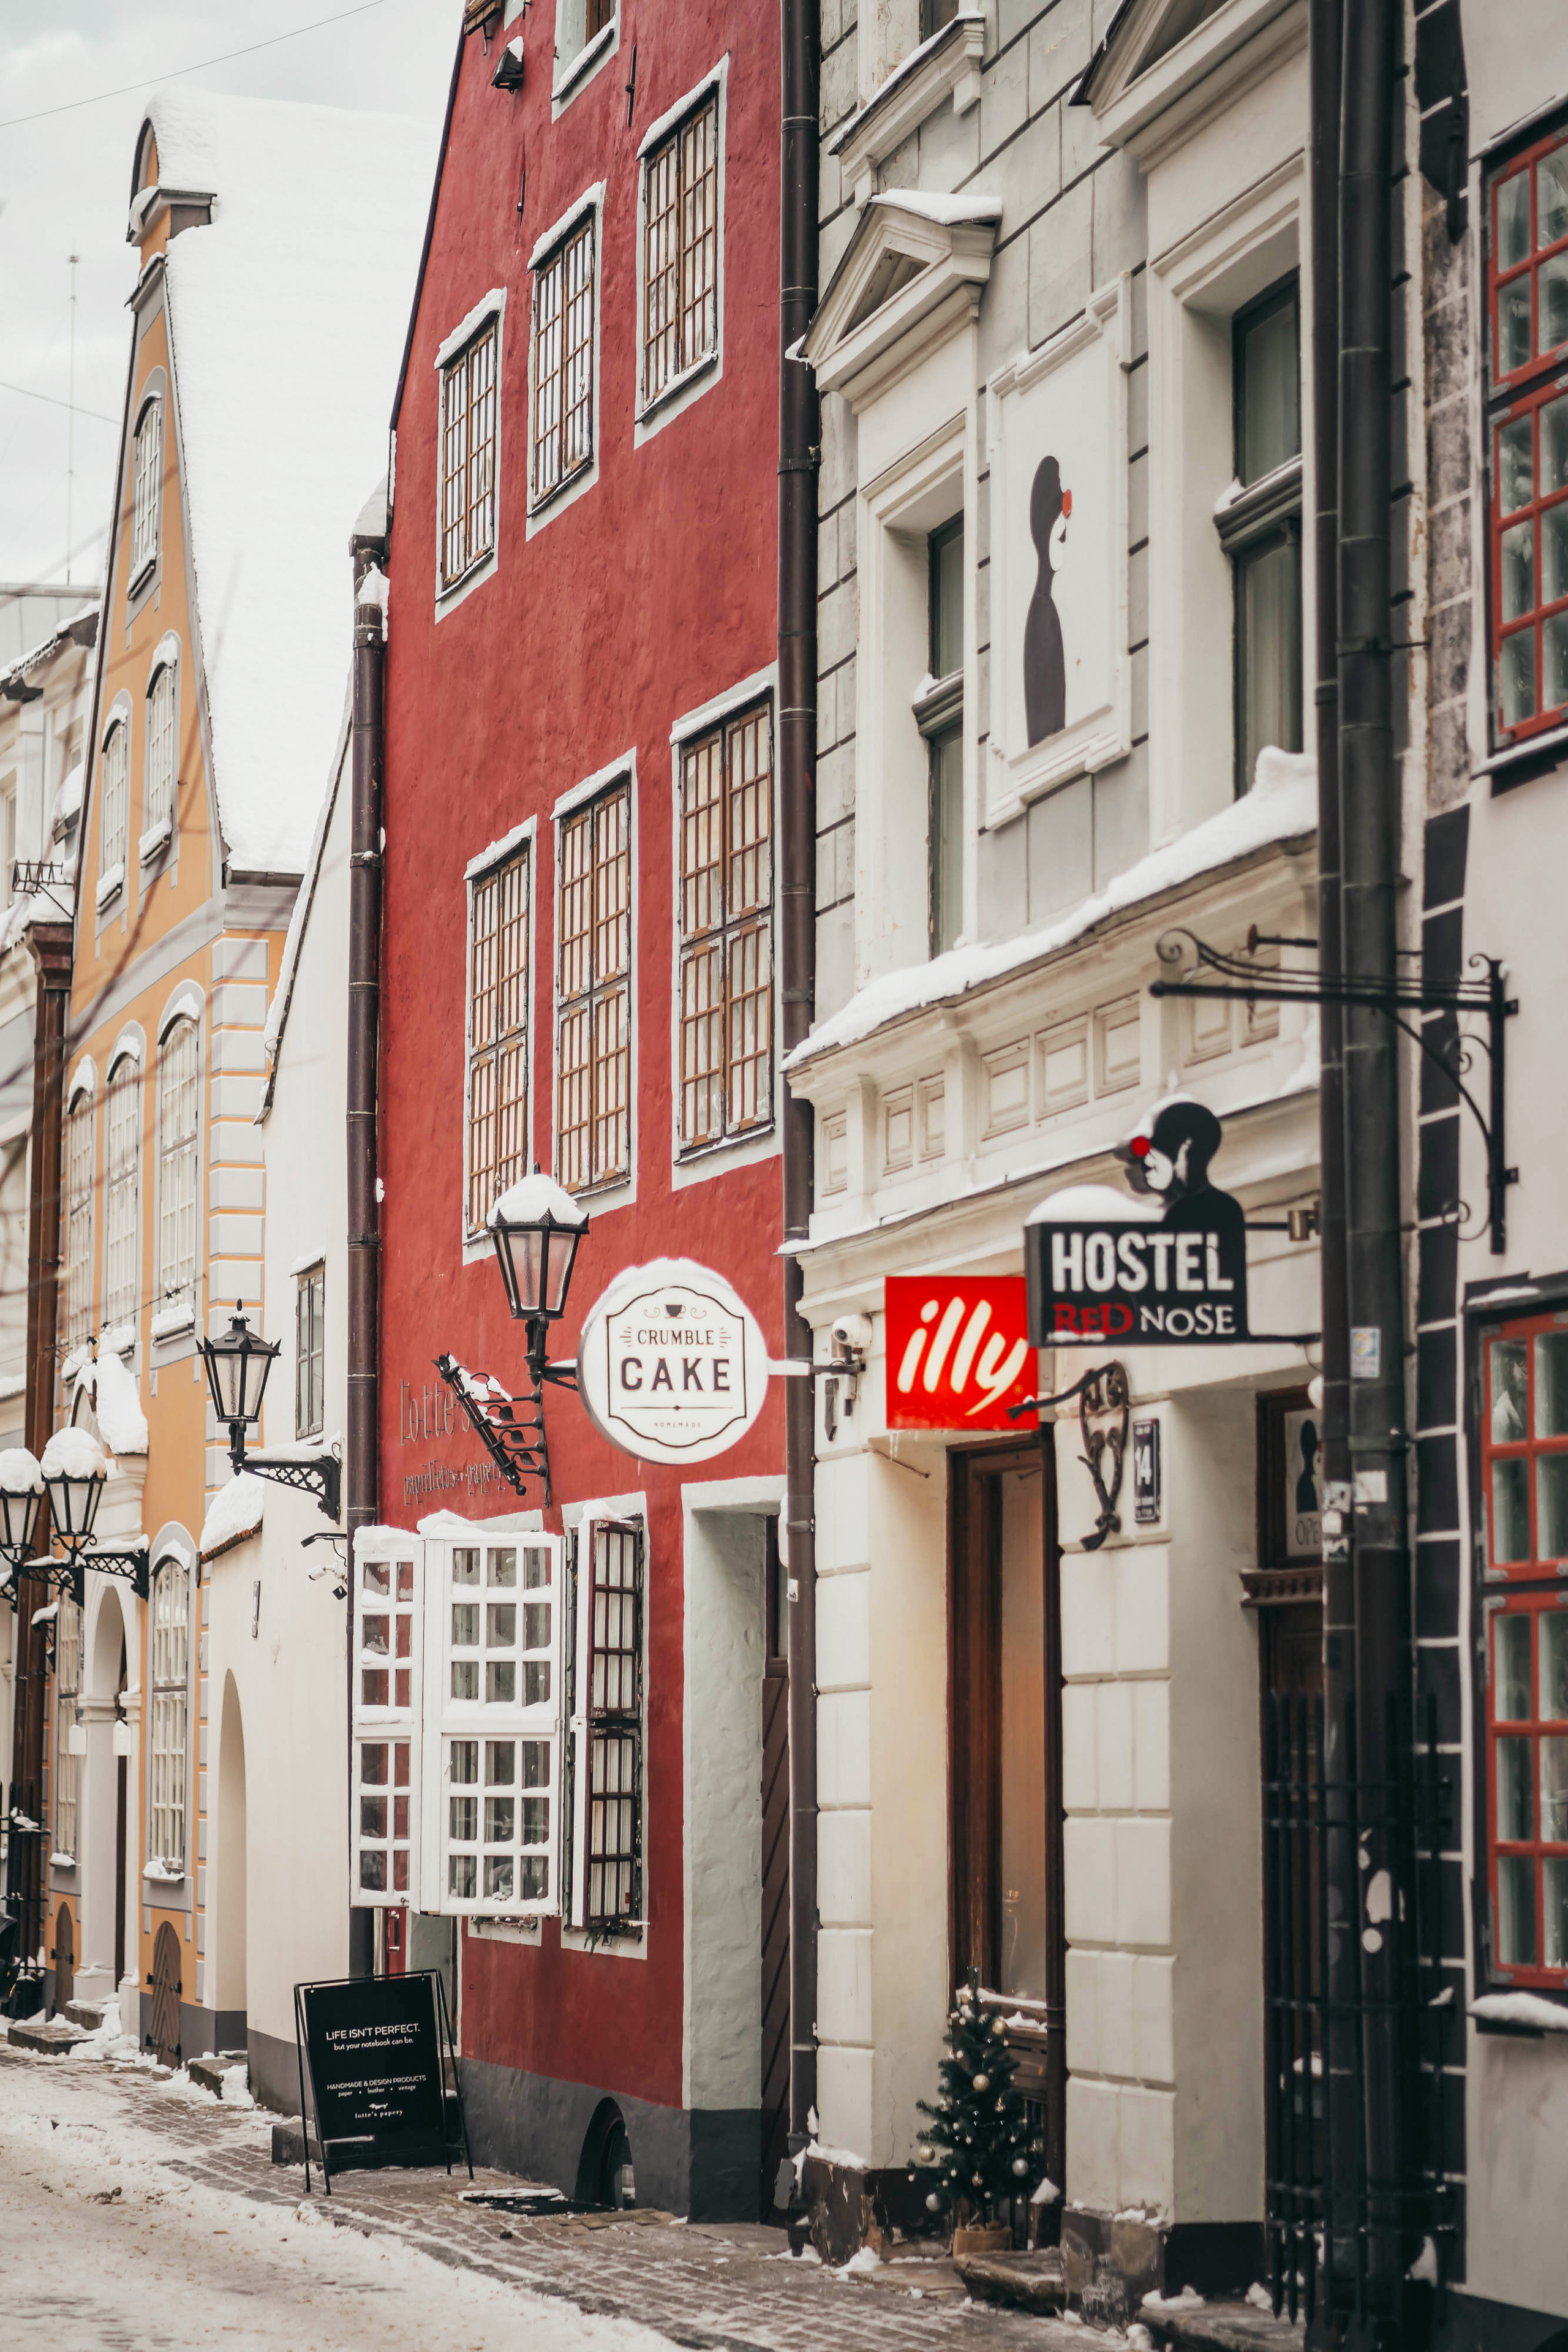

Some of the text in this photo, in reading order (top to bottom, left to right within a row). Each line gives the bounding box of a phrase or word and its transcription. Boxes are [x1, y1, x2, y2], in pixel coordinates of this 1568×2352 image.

[1051, 1232, 1234, 1292] HOSTEL
[1053, 1303, 1237, 1336] RED NOSE
[638, 1329, 715, 1346] CRUMBLE
[897, 1296, 1028, 1415] illy
[620, 1357, 731, 1392] CAKE
[1135, 1444, 1152, 1486] 14
[1295, 1518, 1322, 1545] OPE
[326, 2023, 420, 2041] LIFE ISN'T PERFECT.
[361, 2038, 391, 2048] notebook
[326, 2081, 363, 2090] HANDMADE
[393, 2075, 426, 2083] PRODUCTS
